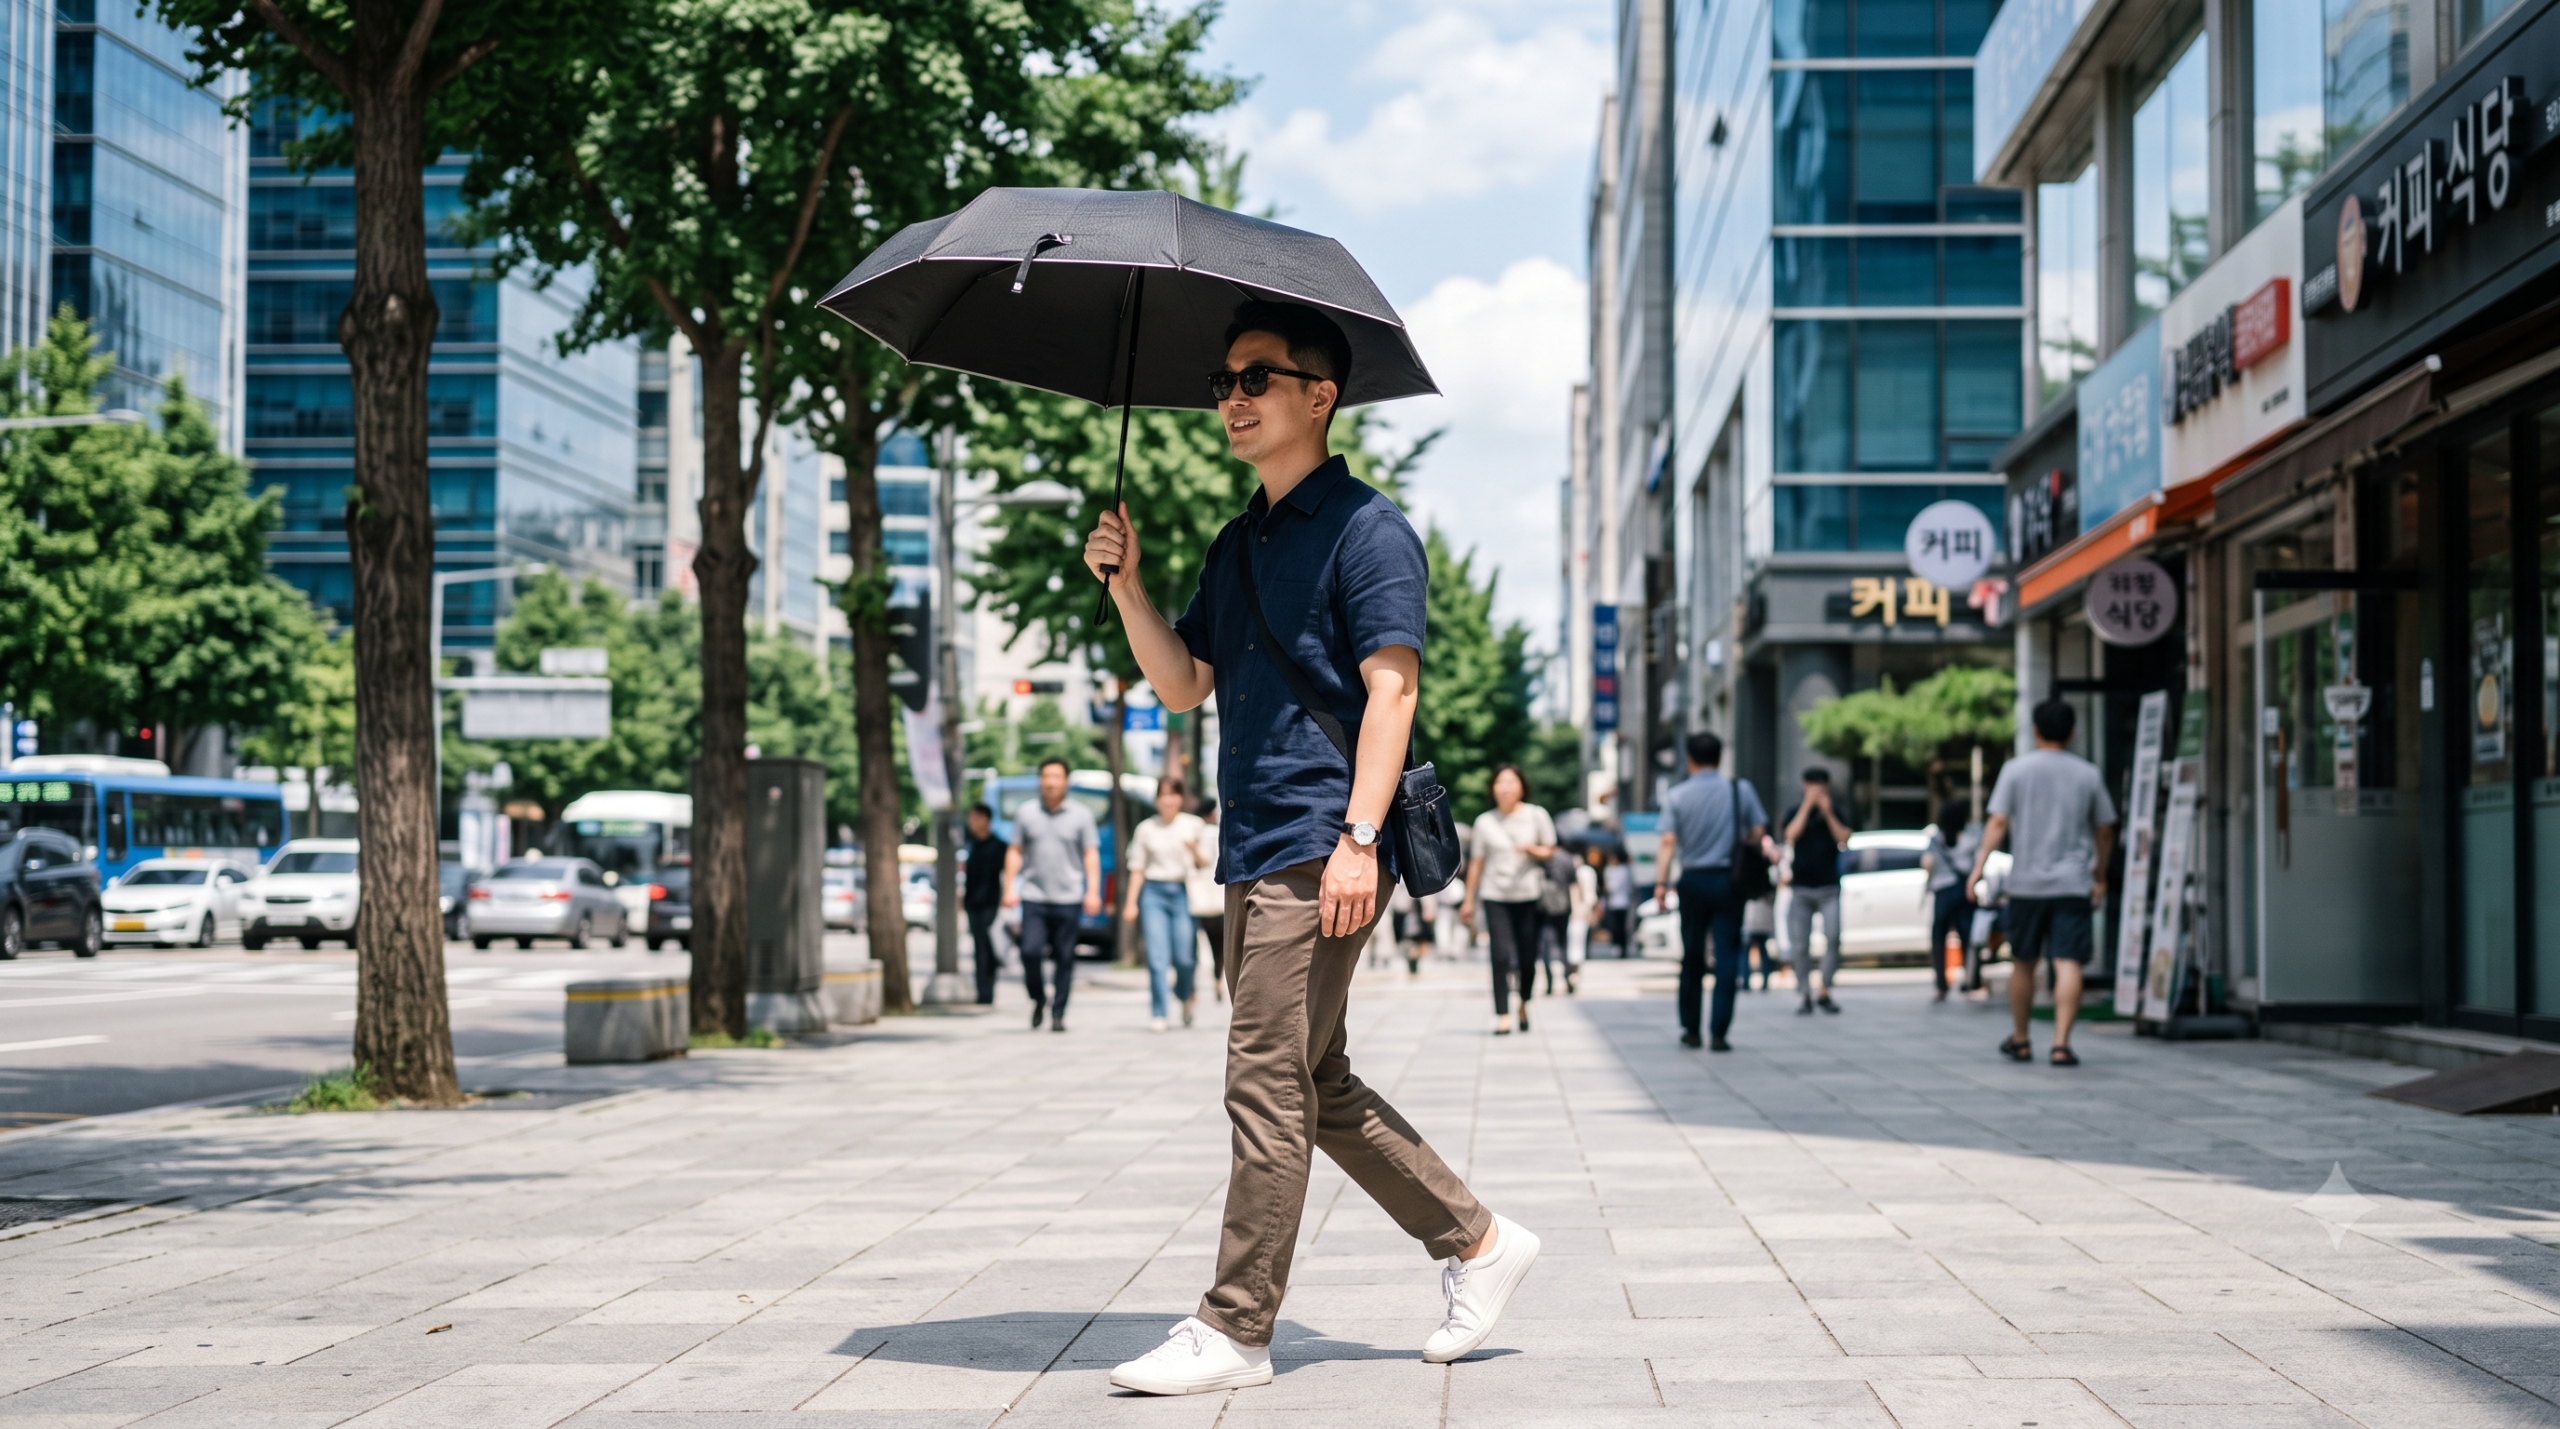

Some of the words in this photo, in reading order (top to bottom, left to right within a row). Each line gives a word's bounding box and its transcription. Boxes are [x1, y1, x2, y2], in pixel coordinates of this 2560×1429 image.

[1921, 527, 1981, 562] 커피
[1851, 576, 1950, 628] 커피
[2105, 600, 2161, 631] 식당
